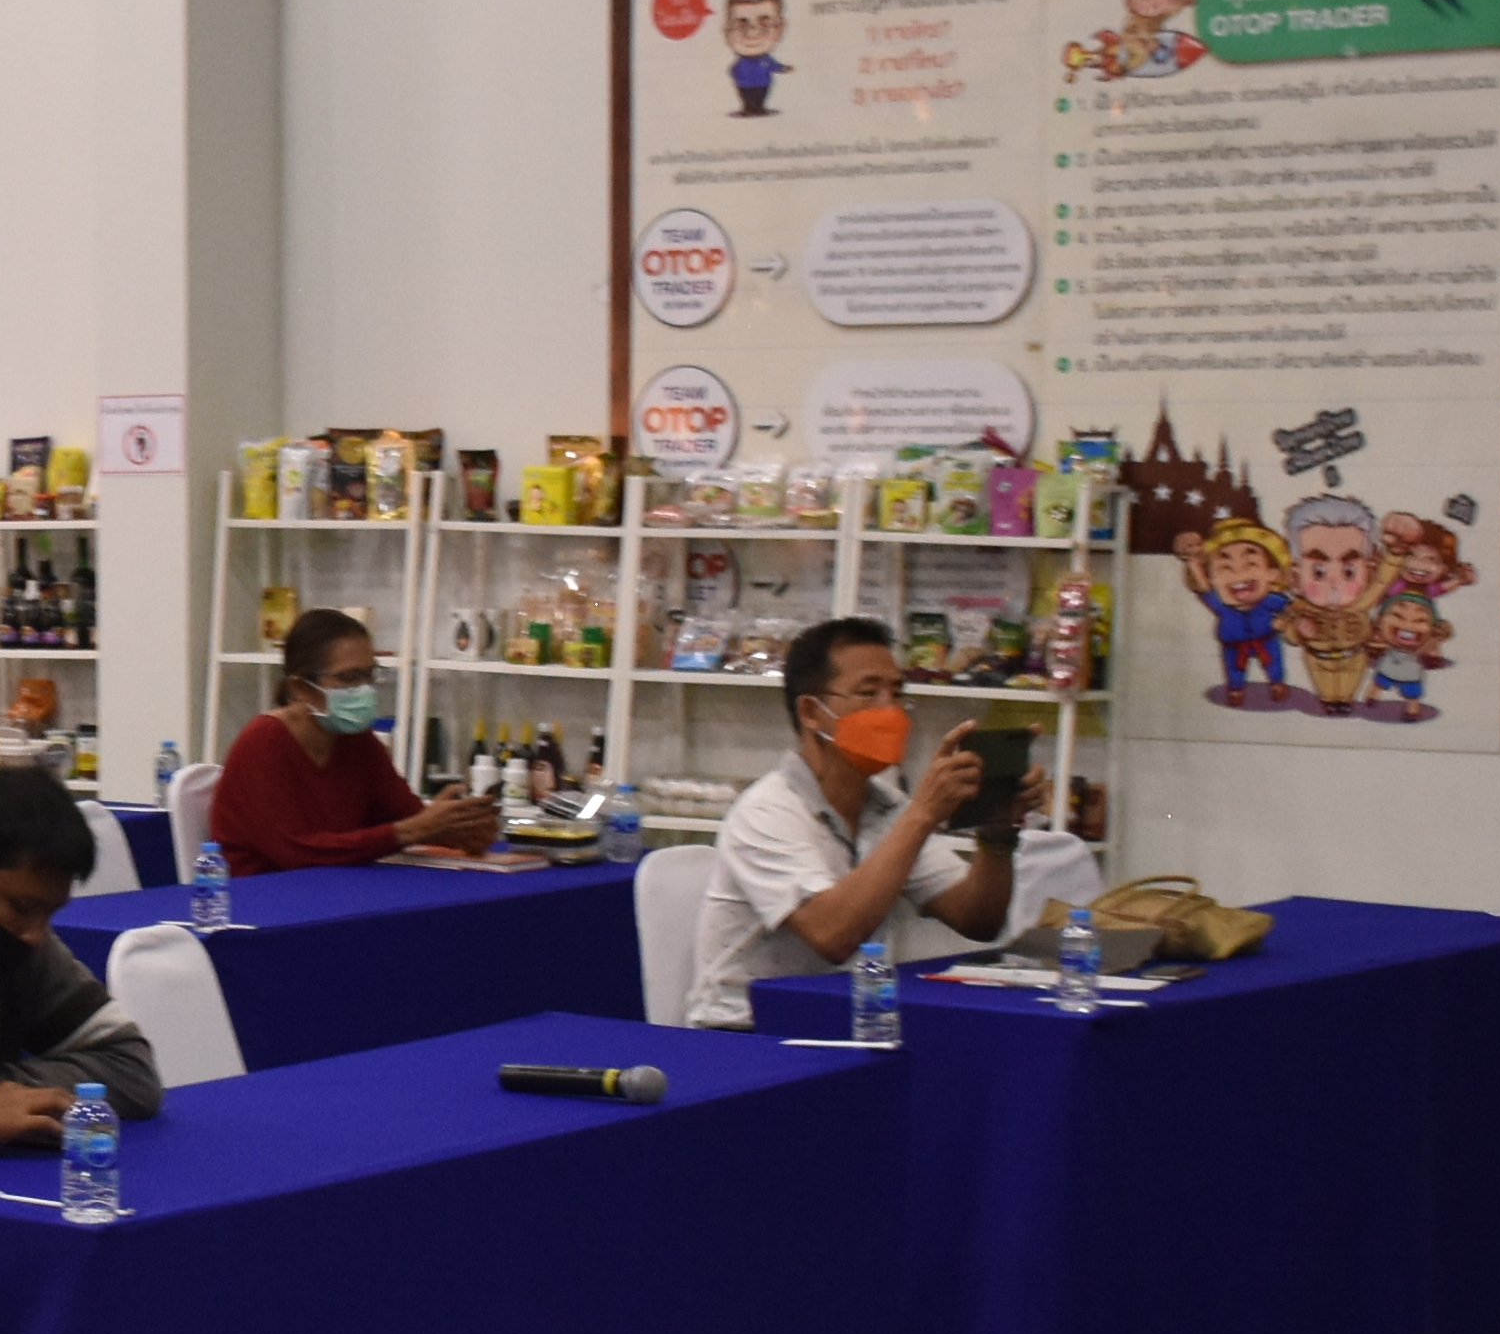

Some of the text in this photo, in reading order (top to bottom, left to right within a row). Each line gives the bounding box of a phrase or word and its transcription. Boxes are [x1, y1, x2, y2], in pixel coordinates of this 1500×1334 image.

[1210, 4, 1390, 38] OTOP TRADER
[642, 248, 725, 276] OTOP
[642, 406, 728, 434] OTOP
